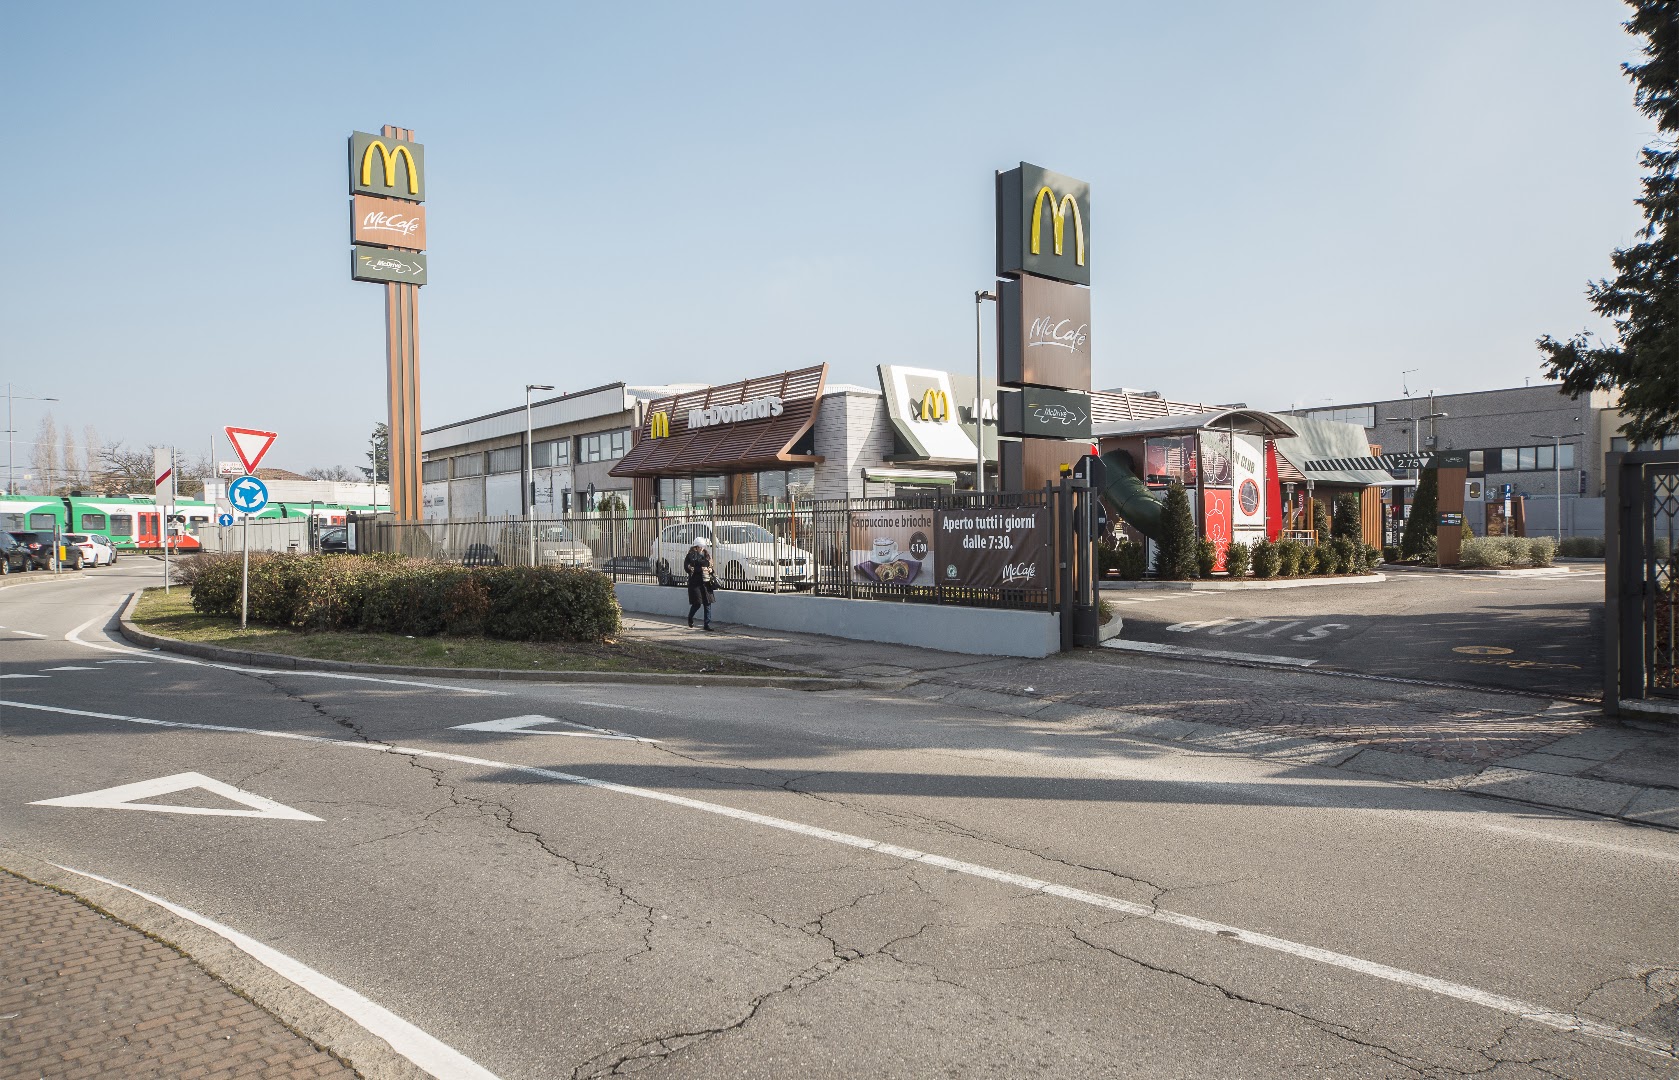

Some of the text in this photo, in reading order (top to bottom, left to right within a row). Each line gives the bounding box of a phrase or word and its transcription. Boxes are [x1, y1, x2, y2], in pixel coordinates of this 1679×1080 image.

[363, 211, 420, 236] McCafé
[1028, 316, 1088, 353] McCafé
[687, 395, 784, 429] McDonald's
[1044, 407, 1068, 418] McDrive
[1397, 459, 1420, 468] 2.75
[851, 514, 932, 531] Cappuccino e brioche
[942, 513, 1035, 533] Aperto tutti i giorni
[962, 534, 1014, 550] dalle 7:30.
[1002, 562, 1036, 584] McCafé
